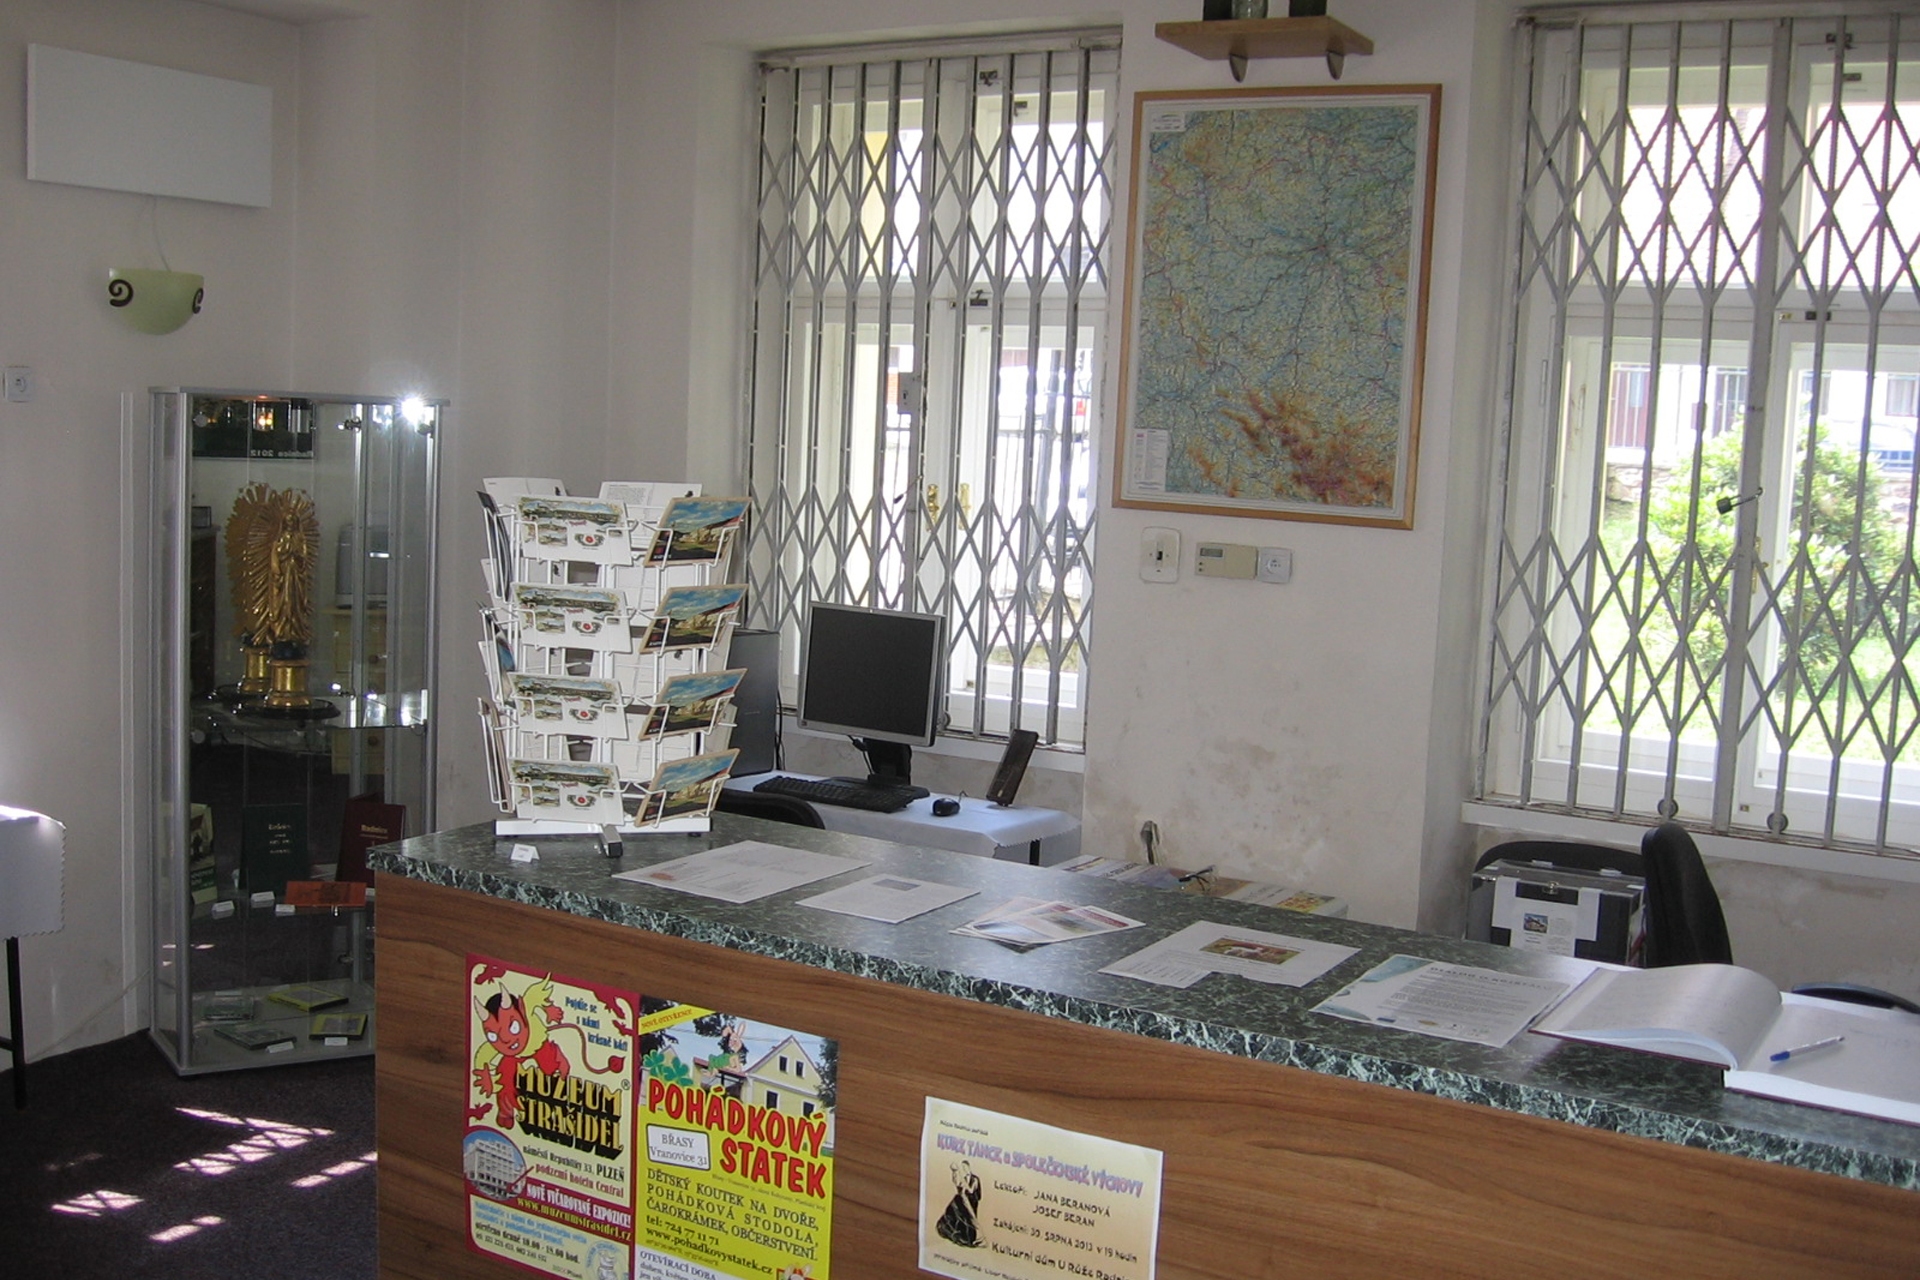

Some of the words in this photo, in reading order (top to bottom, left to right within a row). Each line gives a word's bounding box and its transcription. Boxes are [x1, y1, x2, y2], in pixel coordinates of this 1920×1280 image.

[516, 1063, 623, 1117] MUZEUM
[516, 1095, 624, 1151] STRAŠIDEL
[648, 1078, 827, 1158] POHÁDKOVÝ
[648, 1146, 696, 1163] Vranovice
[697, 1155, 708, 1166] 31
[661, 1133, 695, 1149] BŘASY
[596, 1163, 625, 1182] PLZEŇ
[720, 1137, 827, 1199] STATEK
[968, 1139, 1003, 1166] TANCE
[1091, 1168, 1144, 1199] VÝCHOVY
[595, 1179, 624, 1198] Central
[647, 1168, 691, 1190] DĚTSKÝ
[696, 1183, 744, 1207] KOUTEK
[750, 1199, 767, 1214] NA
[773, 1207, 820, 1232] DVOŘE,
[1034, 1189, 1059, 1204] JANA
[1060, 1196, 1111, 1218] BERANOVÁ
[646, 1196, 729, 1236] ČAROKRÁMEK,
[646, 1215, 662, 1227] tel:
[665, 1221, 683, 1236] 724
[684, 1227, 696, 1239] 77
[697, 1231, 707, 1242] 11
[708, 1235, 719, 1246] 71
[647, 1184, 735, 1220] POHÁDKOVÁ
[744, 1213, 819, 1247] STODOLA,
[1033, 1205, 1062, 1219] JOSEF
[1063, 1212, 1096, 1228] BERAN
[640, 1250, 689, 1273] OTEVÍRACÍ
[646, 1226, 773, 1275] www.pohadkovystatek.cz
[992, 1241, 1033, 1262] Kulturní
[1034, 1250, 1056, 1269] dům
[1057, 1259, 1066, 1270] U
[1068, 1262, 1093, 1278] Růže
[1044, 1231, 1073, 1247] SRPNA
[1115, 1250, 1138, 1264] hodin
